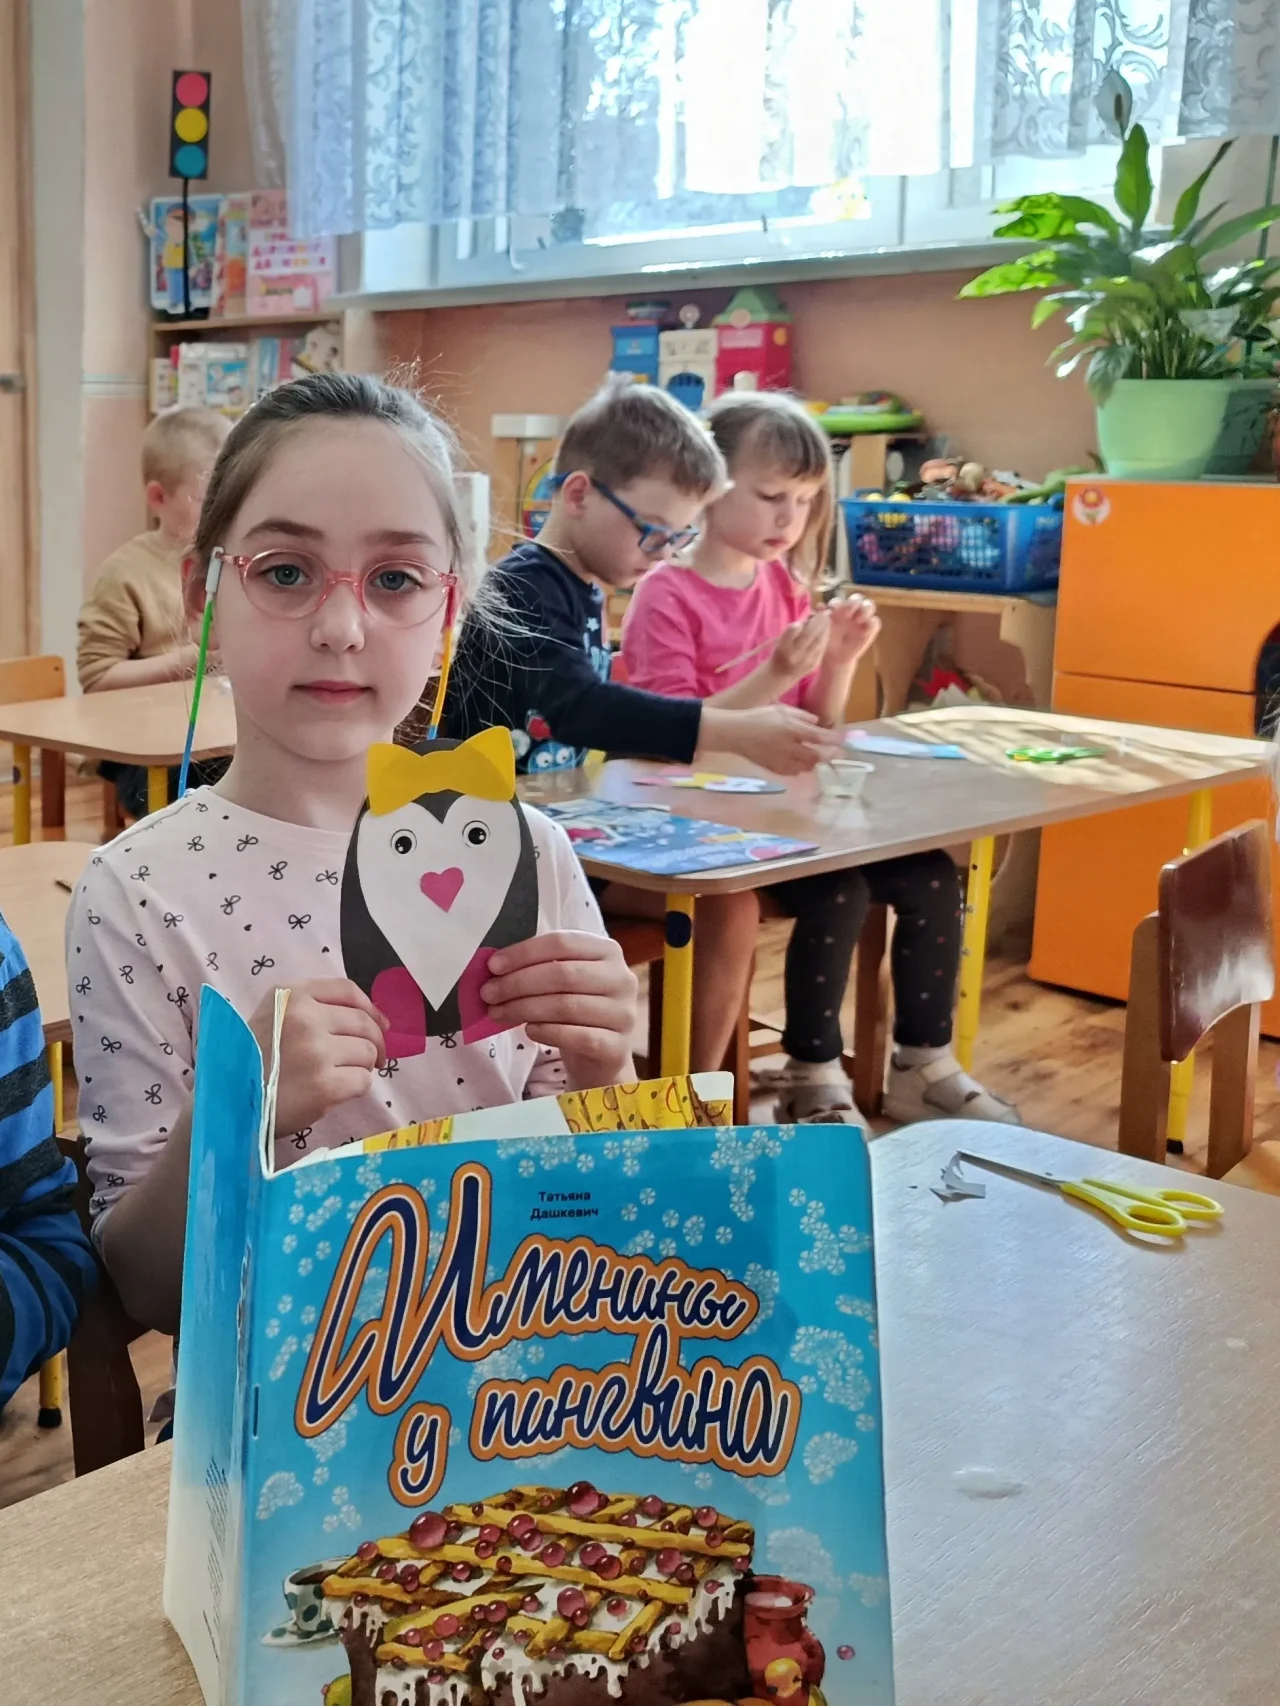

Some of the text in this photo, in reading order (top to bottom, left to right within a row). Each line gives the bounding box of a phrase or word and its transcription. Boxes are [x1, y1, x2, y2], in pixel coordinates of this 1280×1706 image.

[530, 1207, 599, 1221] Дашкевич
[538, 1191, 592, 1202] Татьяна
[302, 1172, 750, 1428] Именины
[478, 1322, 792, 1468] пингвина
